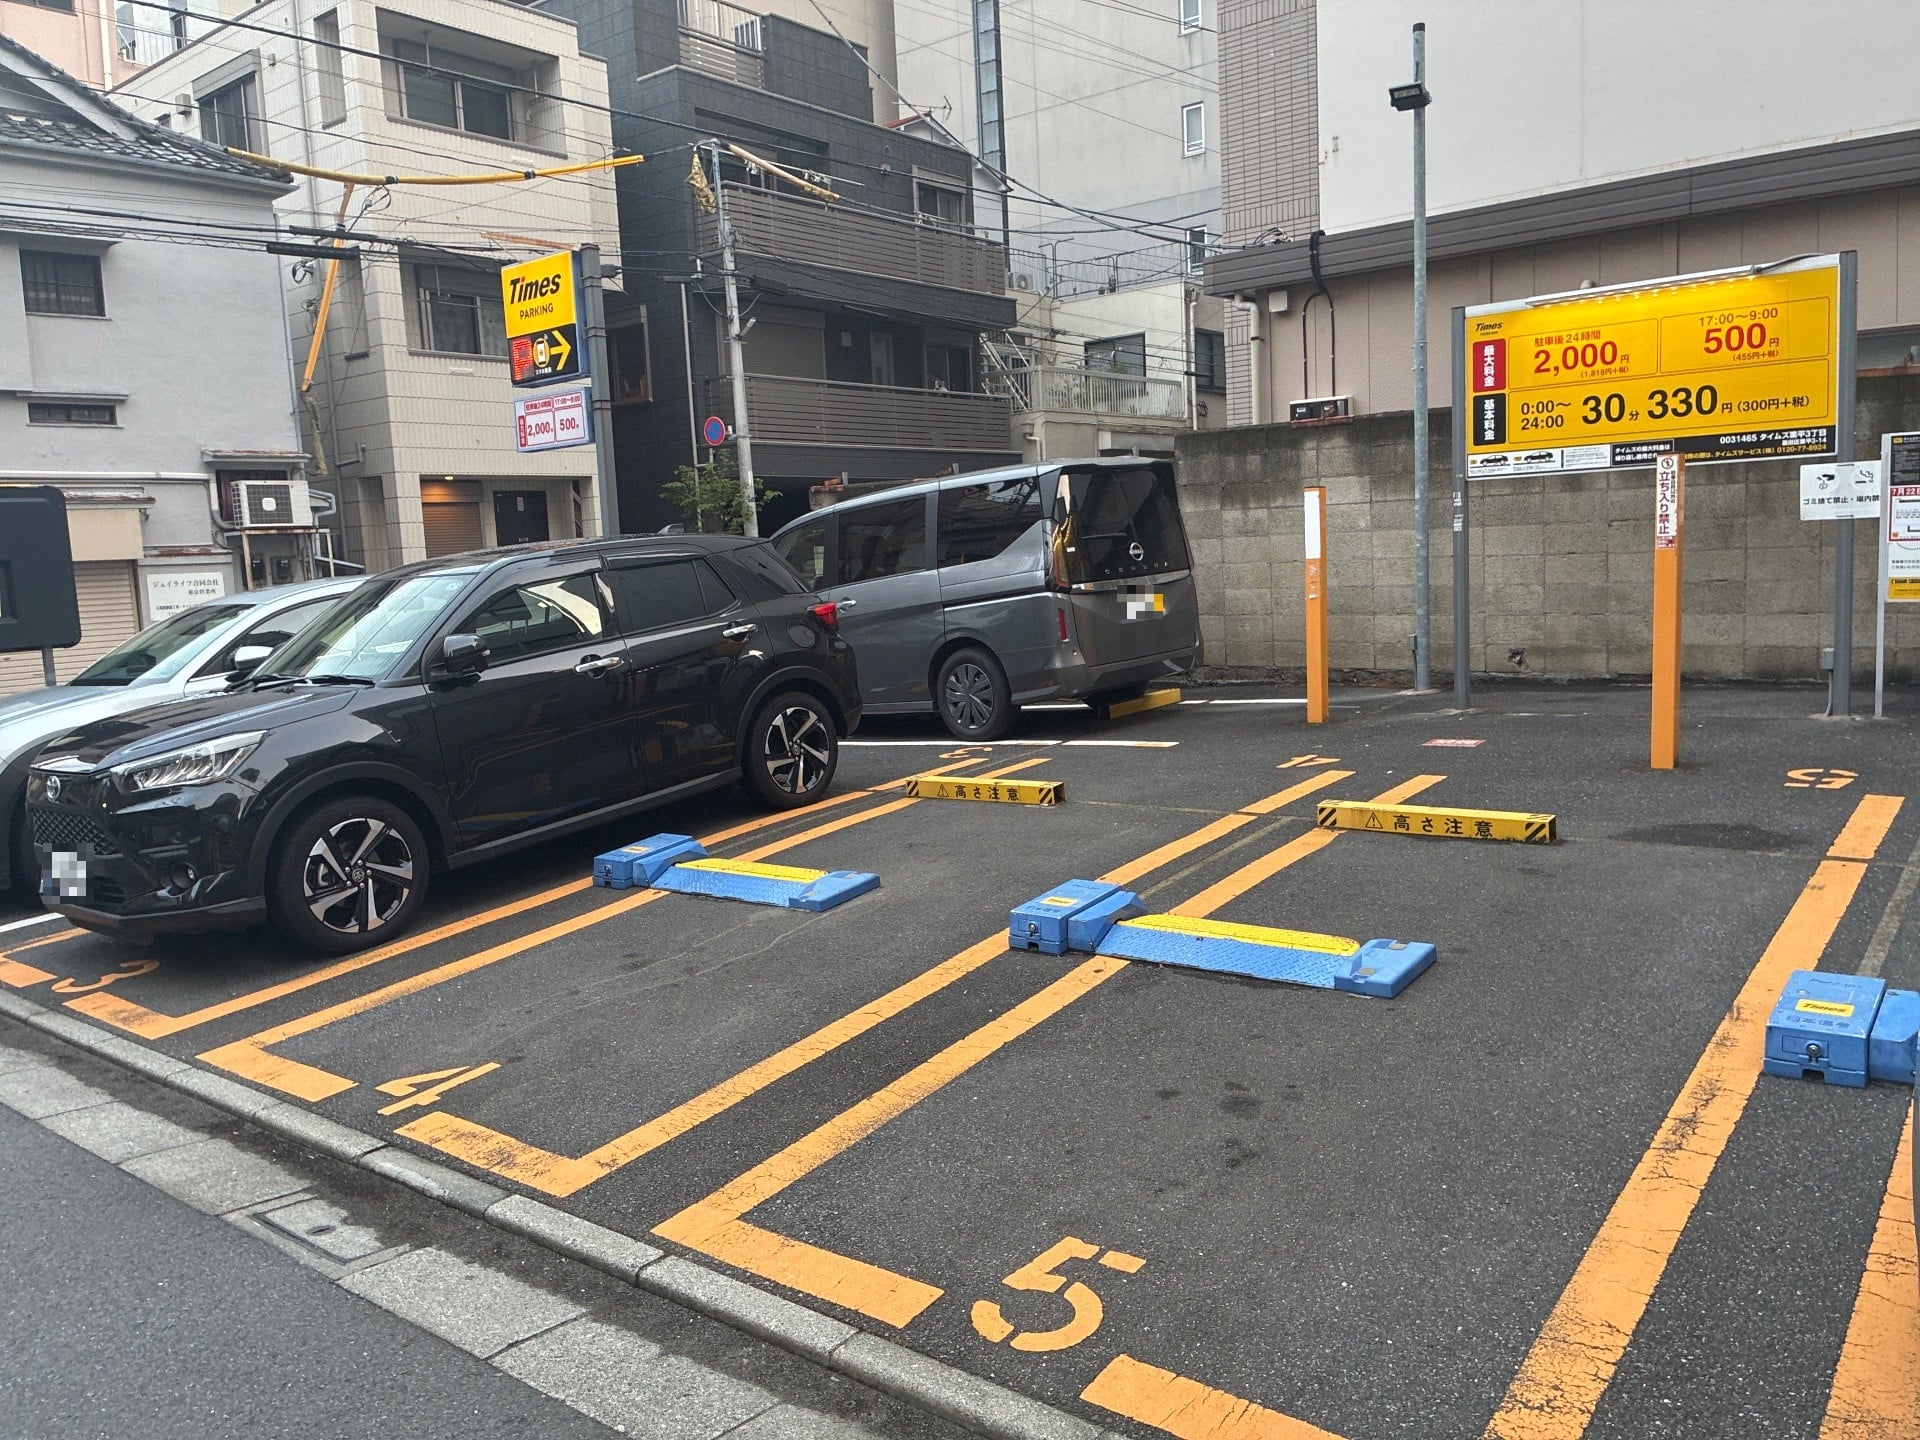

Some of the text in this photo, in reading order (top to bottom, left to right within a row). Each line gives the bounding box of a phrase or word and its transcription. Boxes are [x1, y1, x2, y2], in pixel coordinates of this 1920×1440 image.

[509, 272, 561, 305] Times
[519, 302, 554, 320] PARKING
[1475, 321, 1504, 333] Times
[1534, 330, 1601, 347] 駐車後24時間
[1483, 344, 1495, 387] 最大料金
[527, 421, 554, 438] 2,000
[1484, 398, 1495, 441] 基本料金
[1521, 414, 1565, 431] 24:00
[1719, 434, 1758, 445] 0031465
[1659, 471, 1670, 534] 立ち入り禁止
[954, 785, 1020, 802] 高さ注意
[1392, 814, 1494, 838] 高さ注意
[51, 959, 161, 993] 3
[373, 1061, 502, 1116] 4
[970, 1235, 1147, 1352] 5
